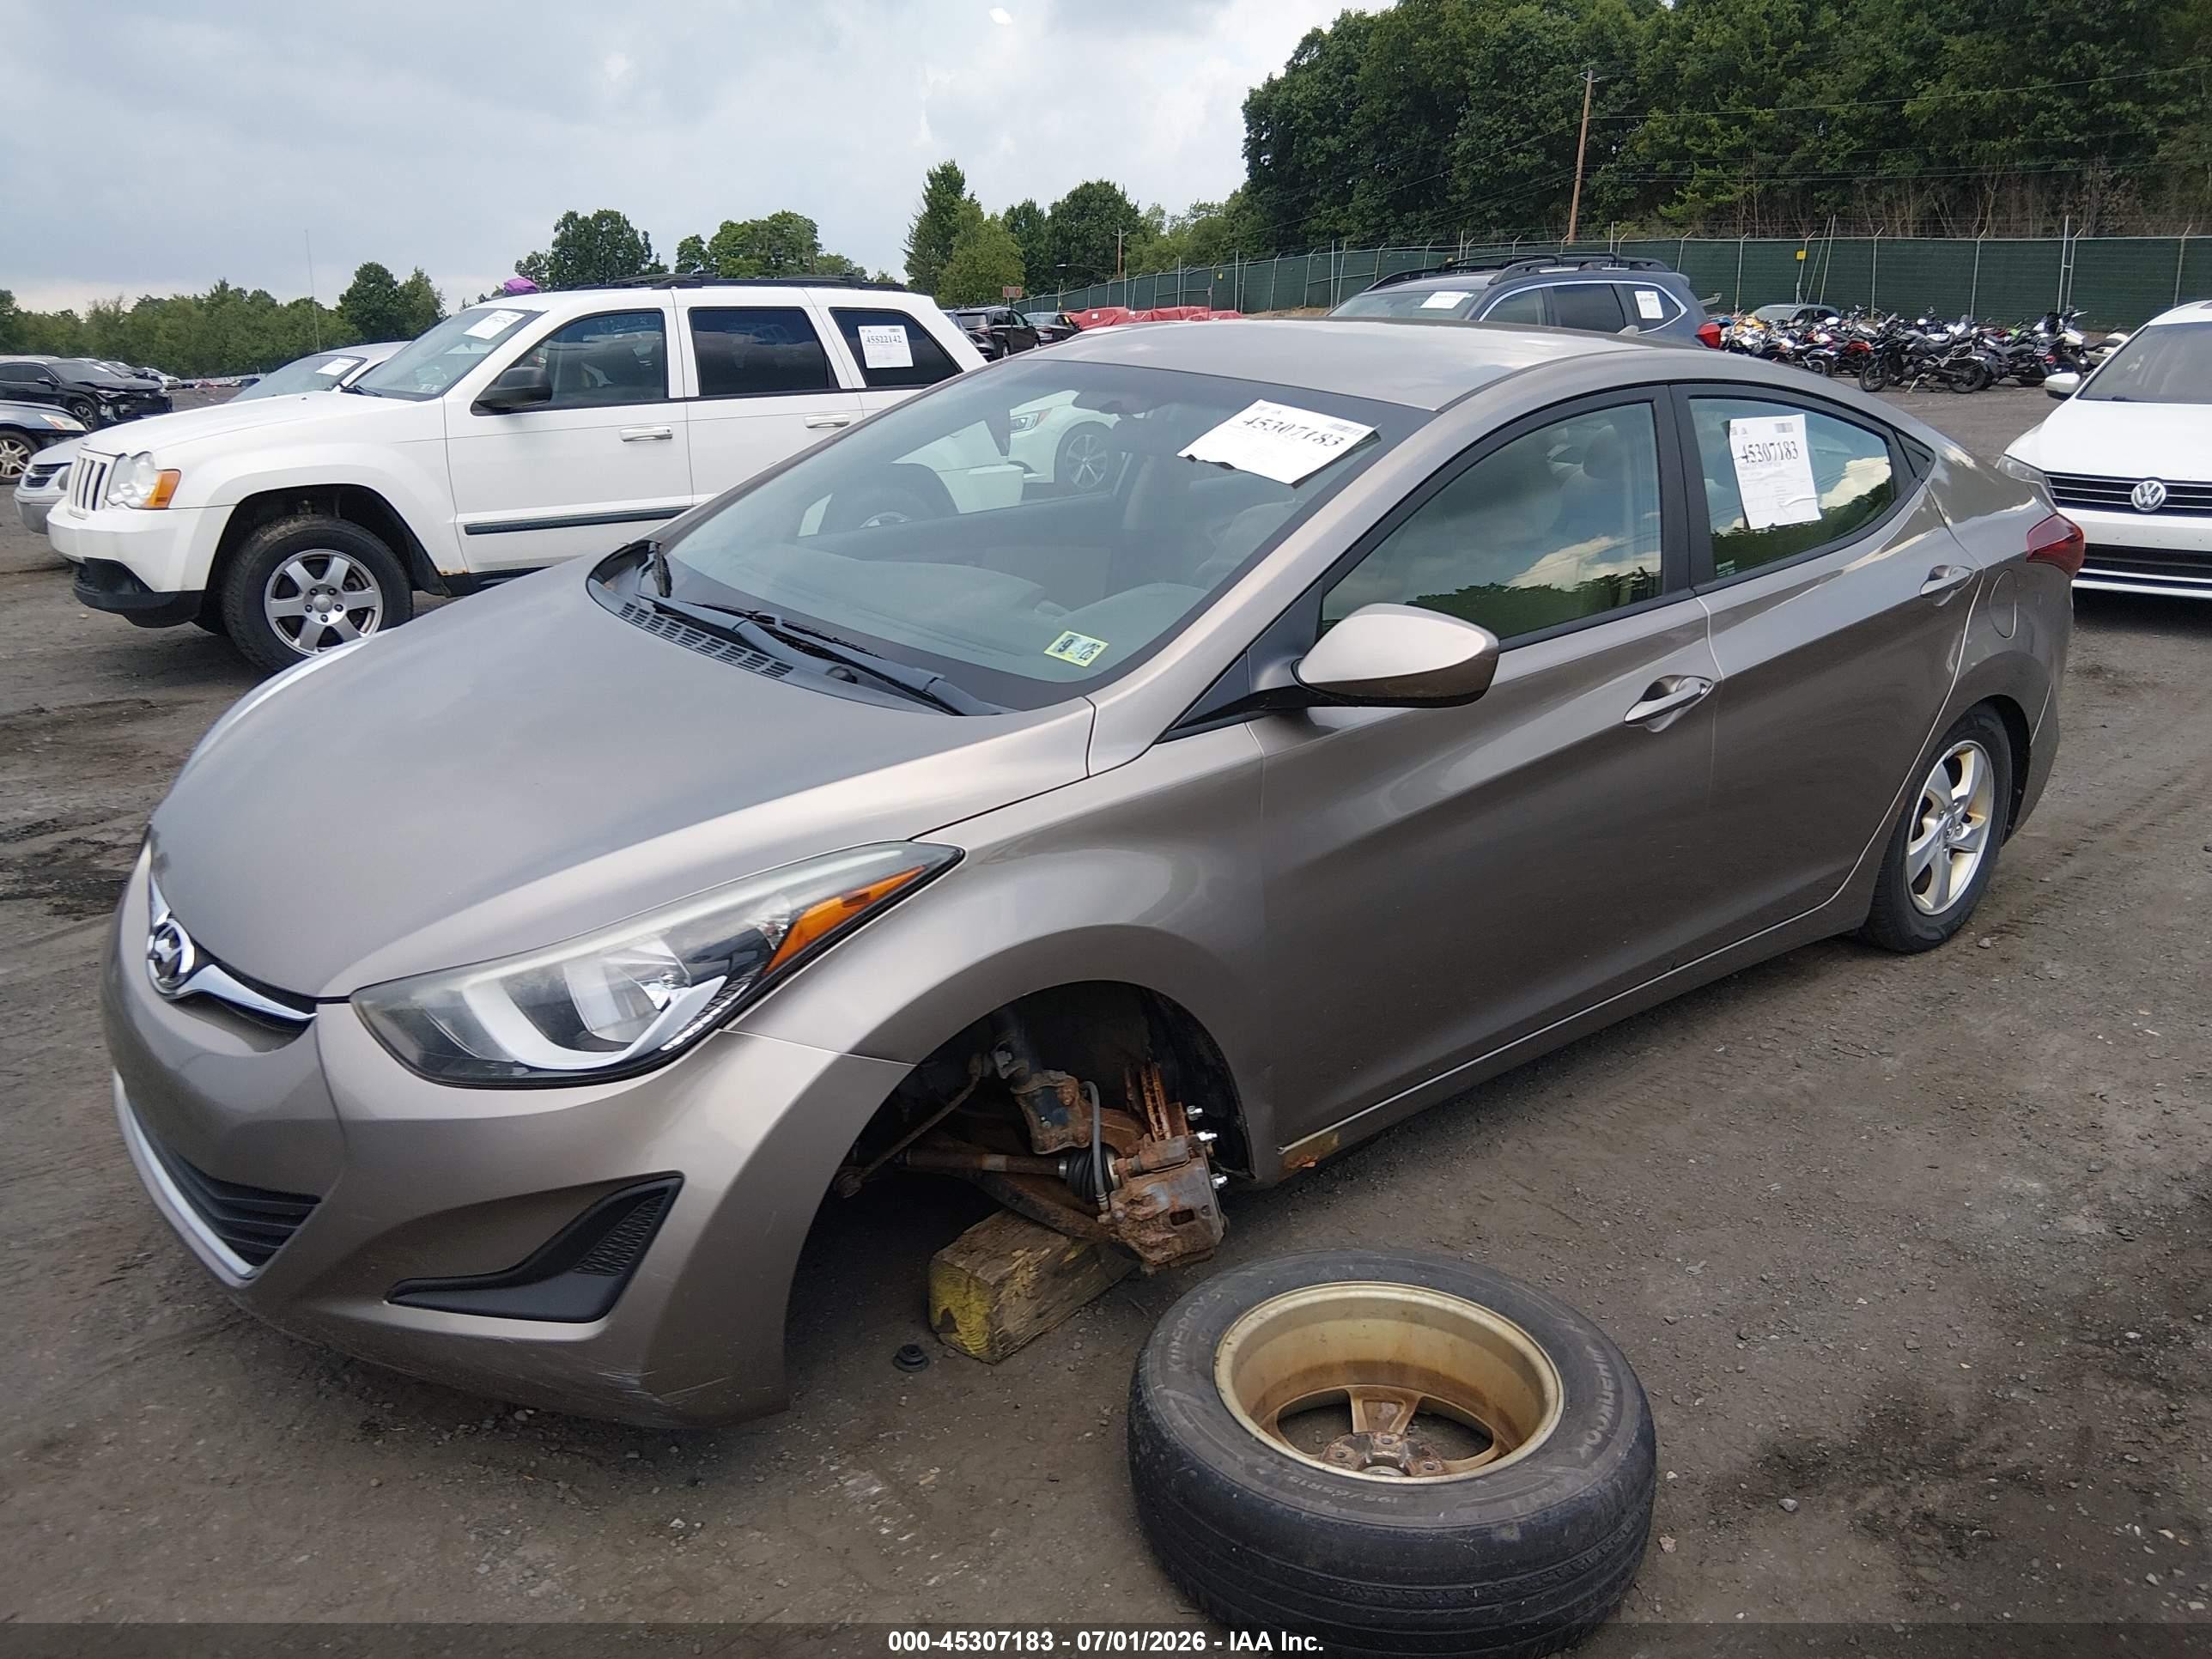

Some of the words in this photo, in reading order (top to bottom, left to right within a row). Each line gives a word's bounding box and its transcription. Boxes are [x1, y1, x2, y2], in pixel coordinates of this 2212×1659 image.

[866, 334, 903, 343] 45522142
[1243, 416, 1346, 447] 45307183
[1741, 441, 1799, 464] 45307183
